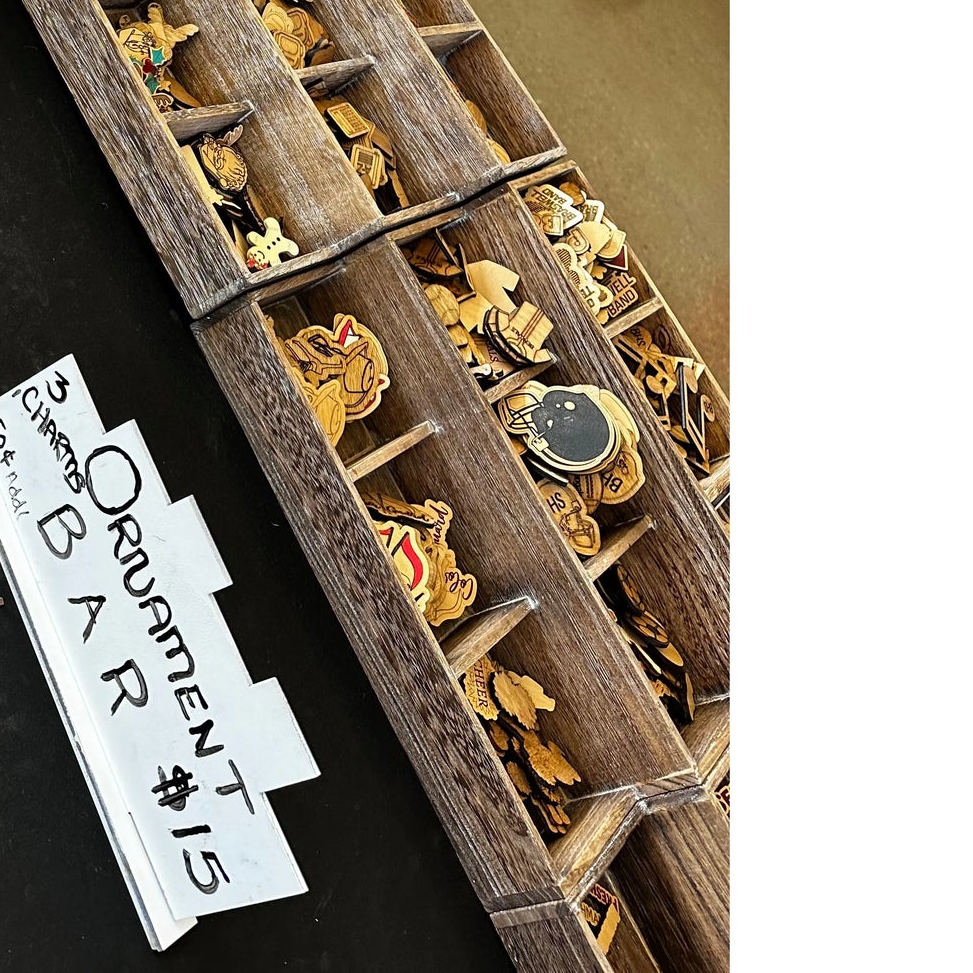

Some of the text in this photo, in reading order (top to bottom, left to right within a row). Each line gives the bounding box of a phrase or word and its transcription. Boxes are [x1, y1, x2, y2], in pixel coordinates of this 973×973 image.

[541, 187, 568, 206] BAND
[608, 288, 637, 316] BAND
[46, 370, 71, 405] 3
[21, 385, 87, 495] CHARMS
[546, 492, 567, 514] HS
[84, 443, 256, 815] ORNAMENT
[37, 503, 231, 896] BAR $15
[473, 659, 489, 708] CHEER
